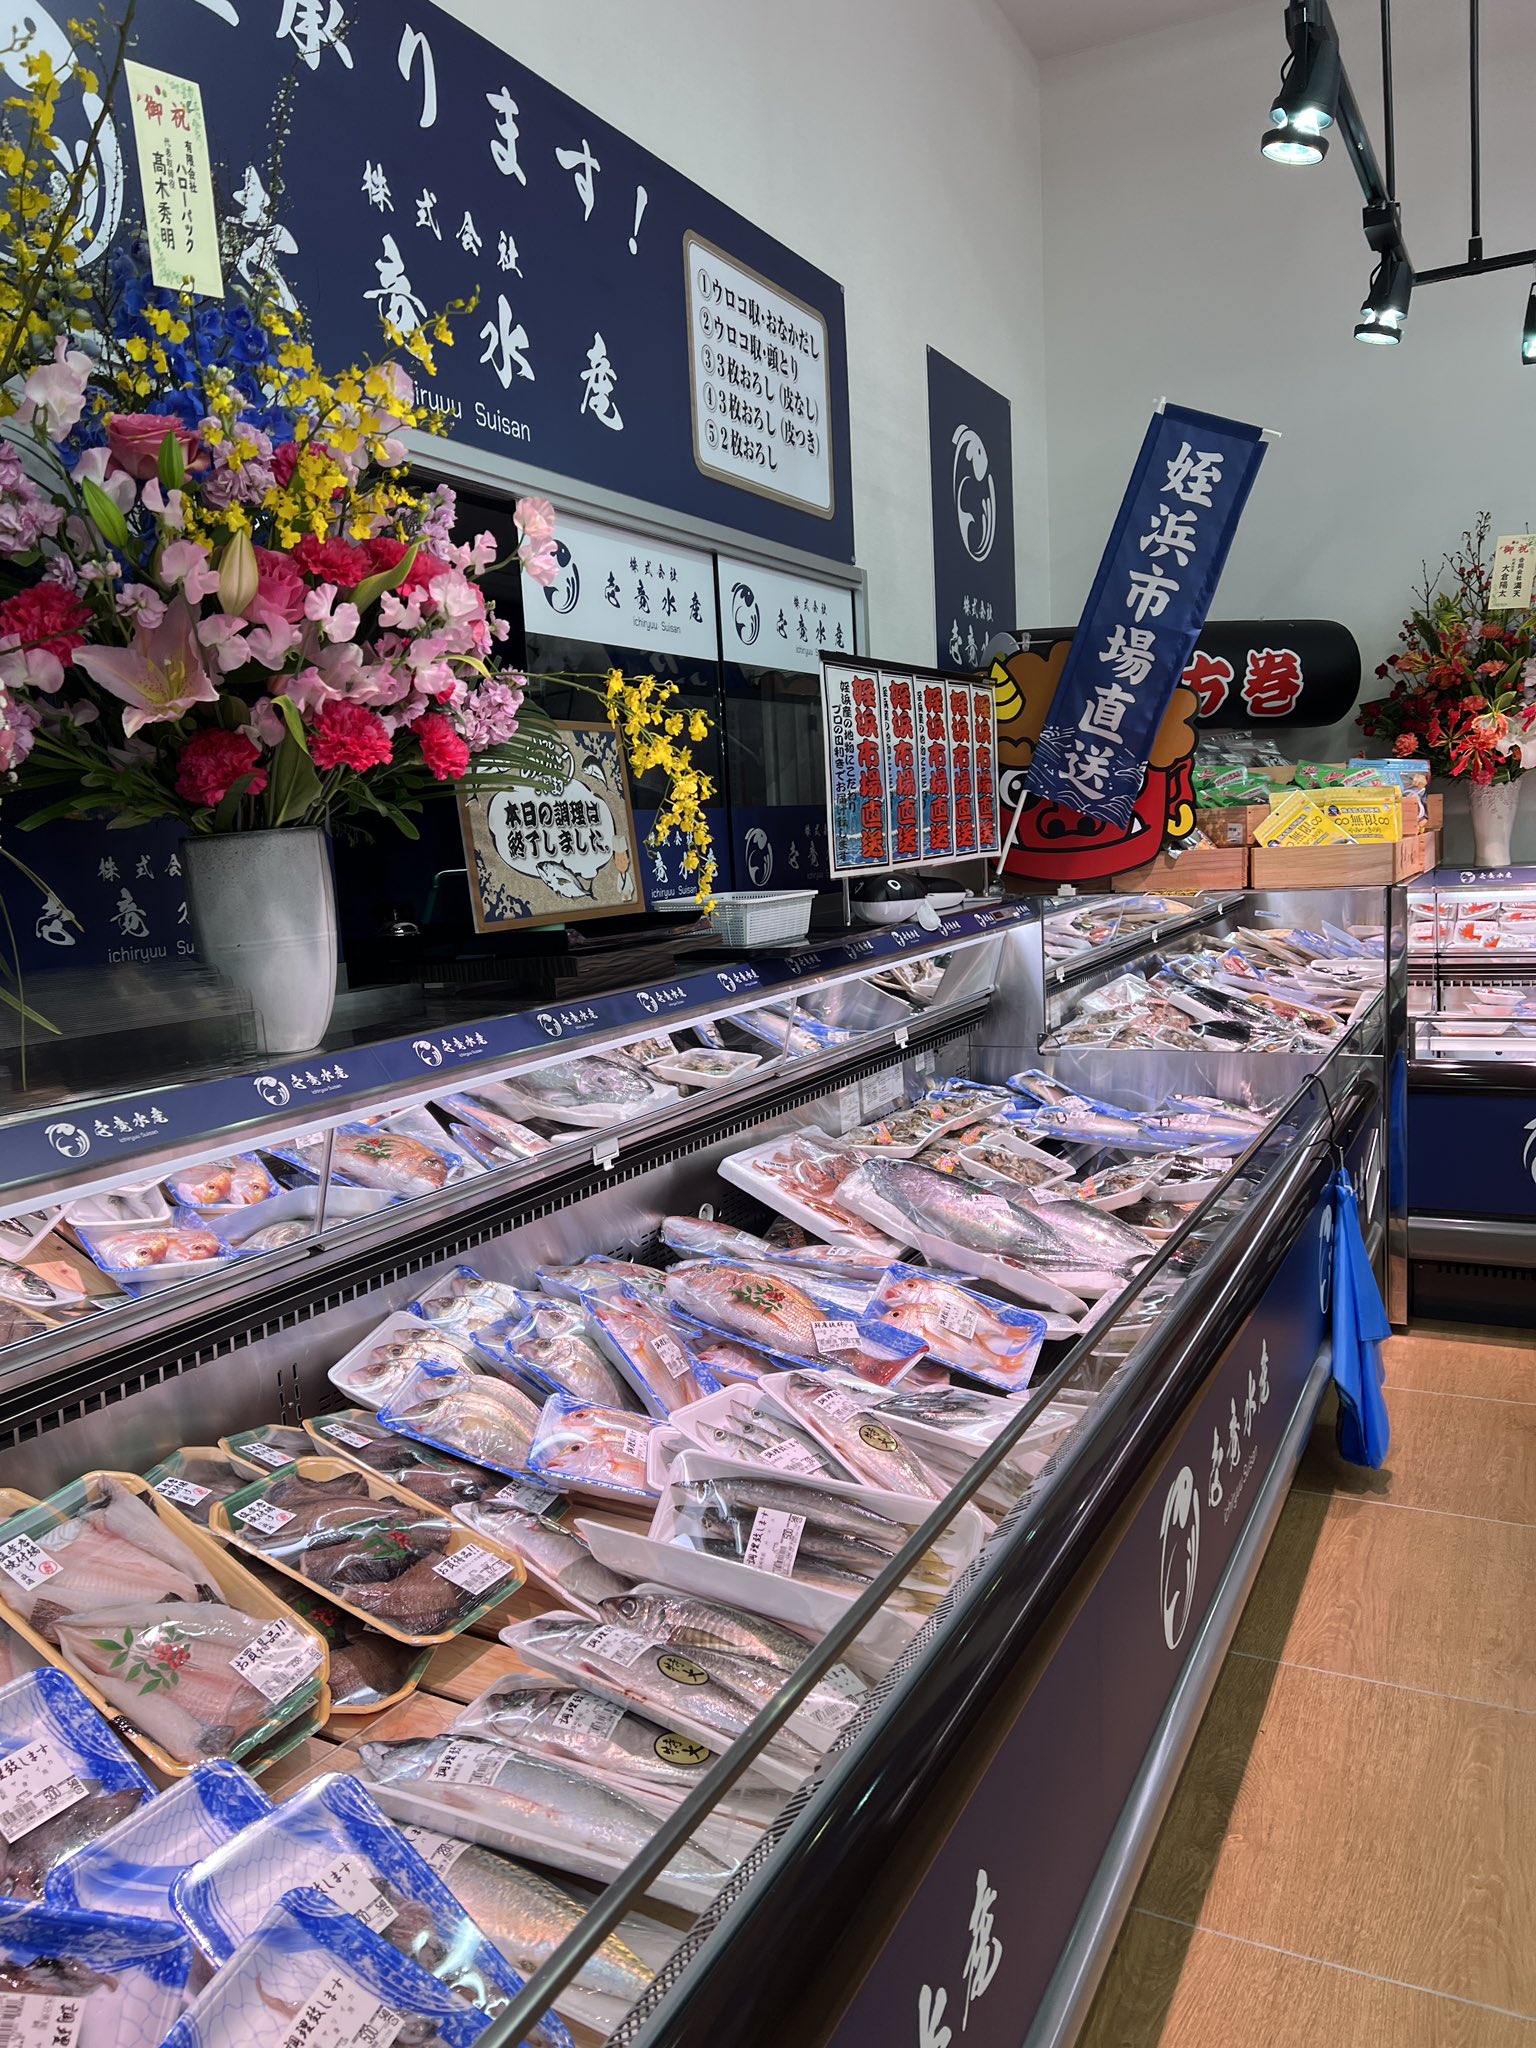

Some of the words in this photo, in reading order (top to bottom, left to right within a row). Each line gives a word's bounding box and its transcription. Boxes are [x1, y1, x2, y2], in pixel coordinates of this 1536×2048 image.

[145, 94, 190, 131] 御祝
[194, 0, 648, 255] 承ります!
[184, 140, 198, 194] 有限会社
[176, 163, 194, 254] ハローパック
[361, 159, 524, 279] 株式会社
[475, 401, 531, 442] Suisan
[629, 556, 679, 583] 株式会社
[661, 622, 681, 635] Suisan
[1060, 441, 1225, 801] 姪浜市場直送
[852, 674, 885, 859] 姪浜市場直送
[889, 679, 917, 854] 姪浜市場直送
[924, 684, 950, 850] 姪浜市場直送
[949, 689, 975, 847] 姪浜市場直送
[973, 691, 995, 845] 姪浜市場直送
[503, 800, 601, 829] 本日の調理は
[507, 828, 610, 860] 終了しました。
[107, 945, 167, 964] ichiryuu
[664, 1656, 705, 1683] 特大
[660, 1737, 706, 1761] 特大
[44, 1785, 62, 1803] 500
[359, 2023, 379, 2044] 500
